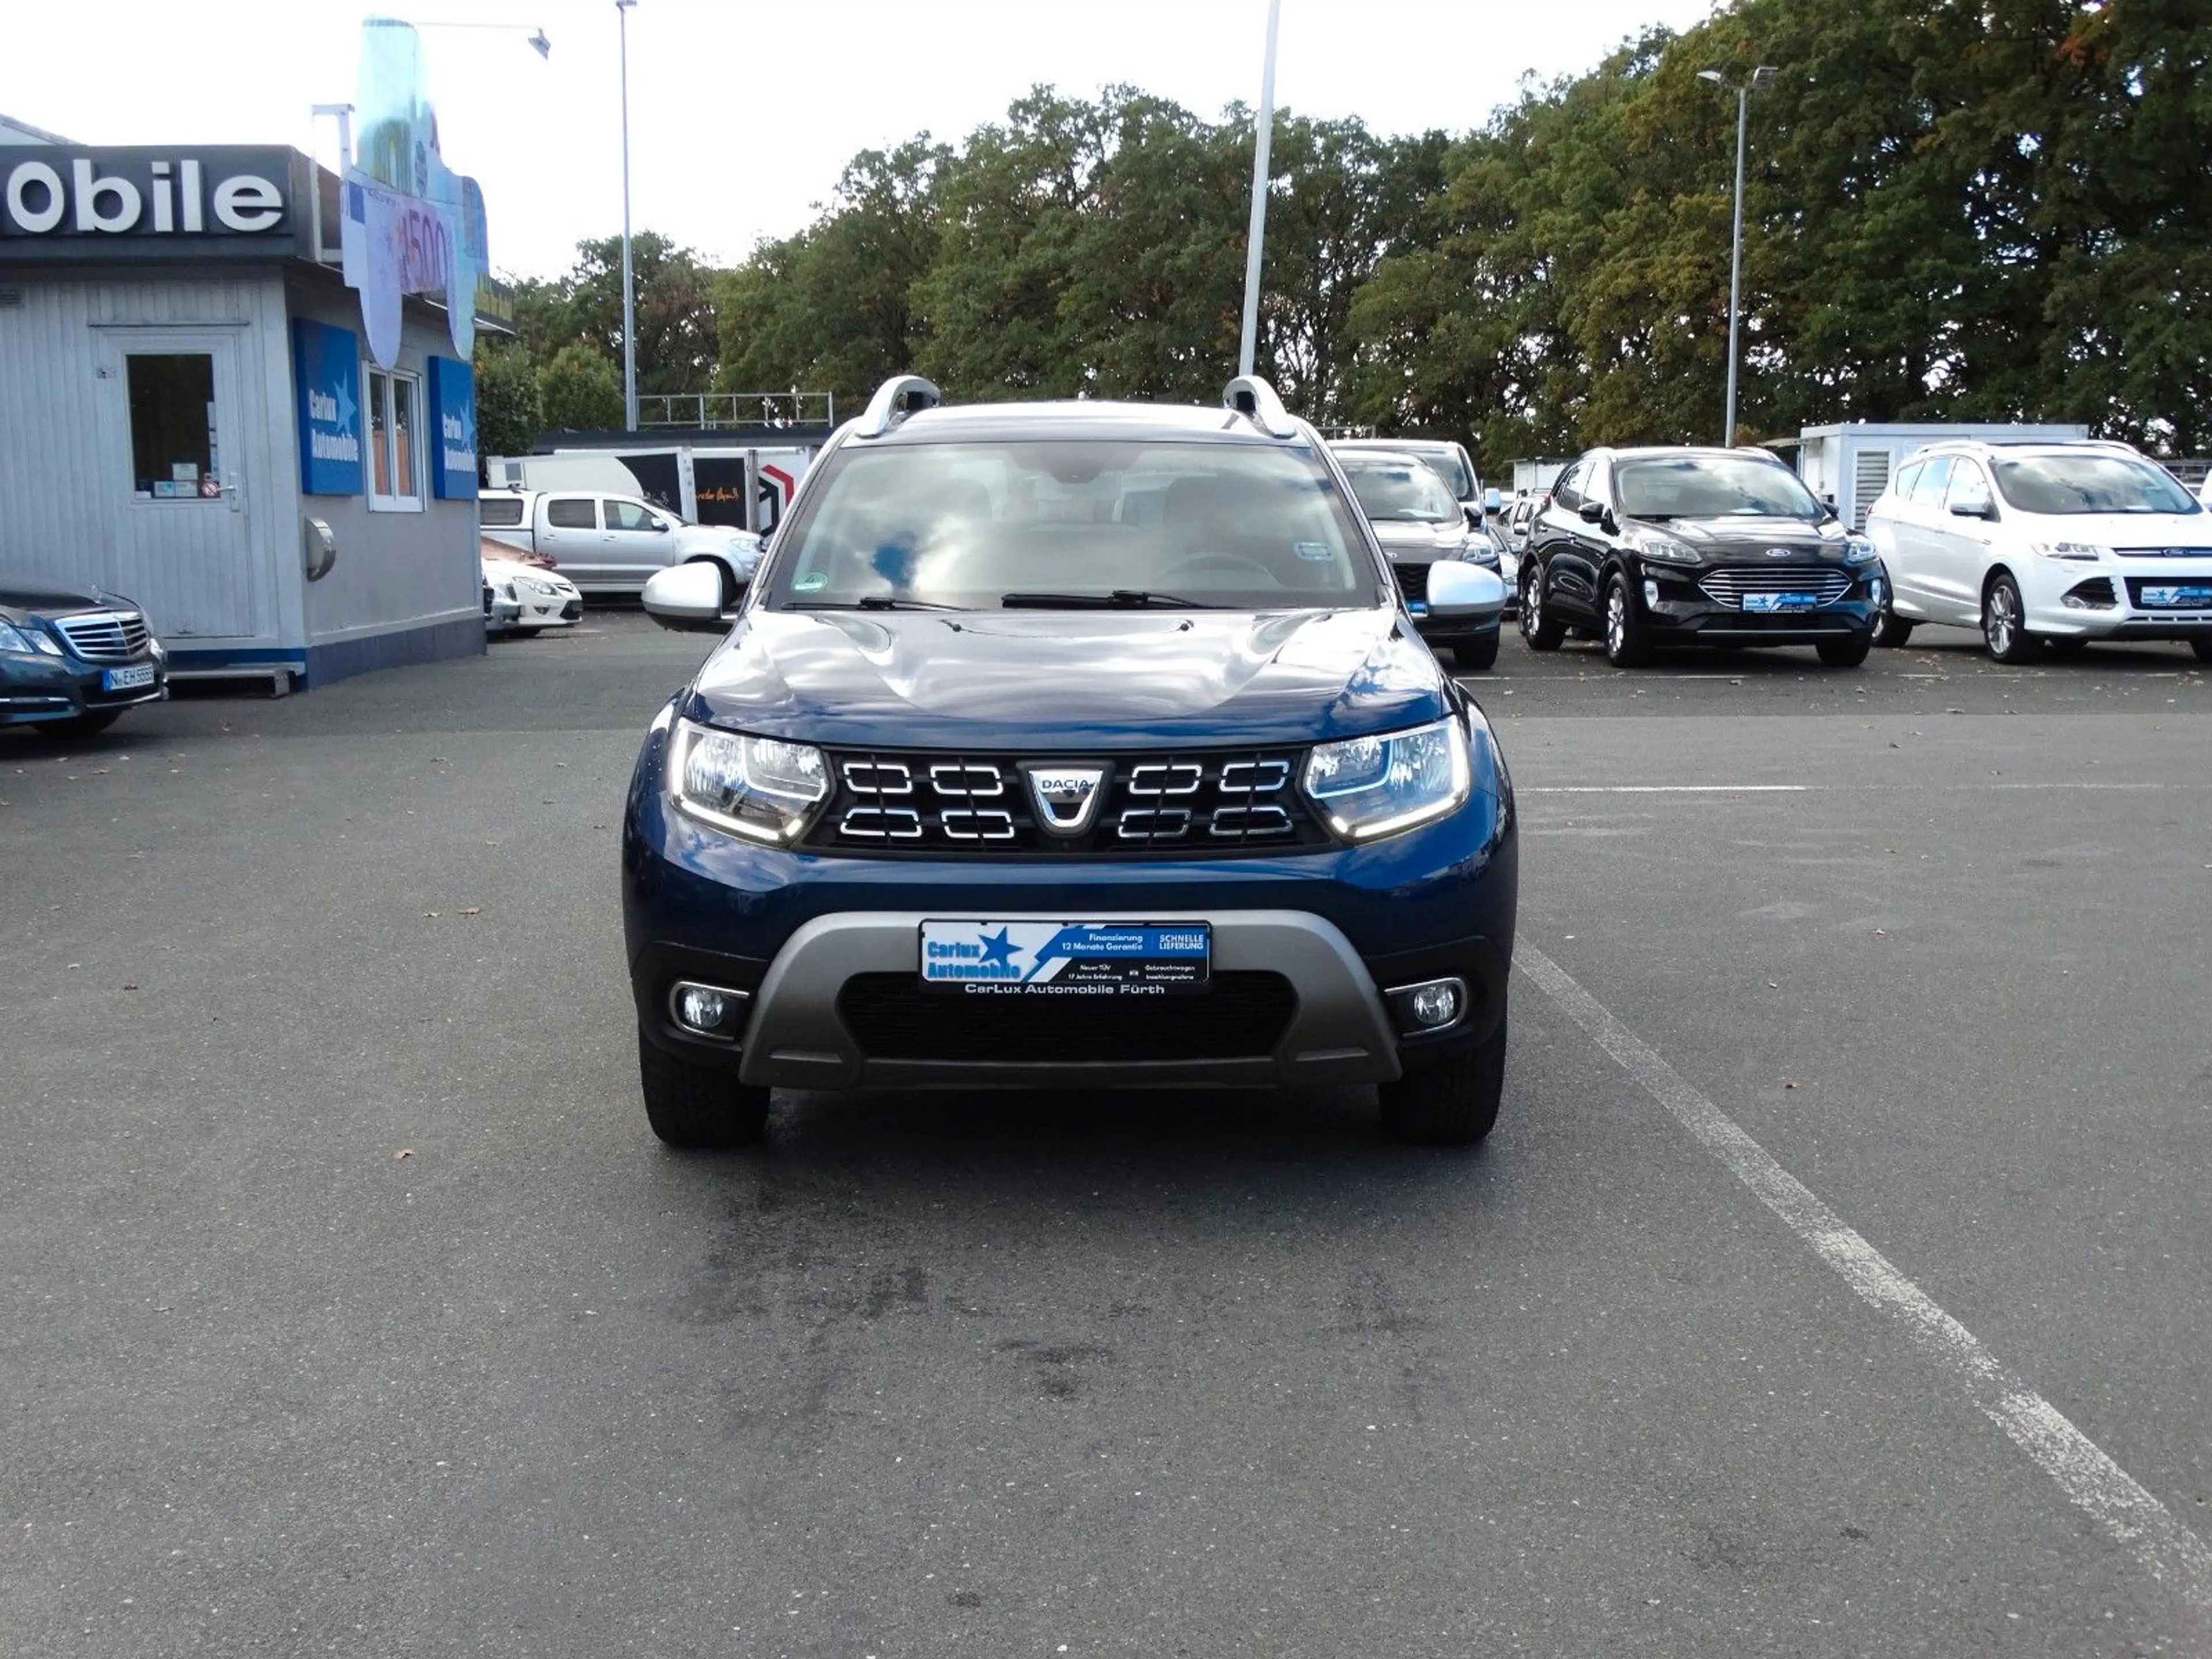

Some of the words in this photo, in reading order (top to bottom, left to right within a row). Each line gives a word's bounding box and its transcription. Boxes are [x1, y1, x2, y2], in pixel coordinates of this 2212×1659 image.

[1042, 779, 1089, 789] DACIA
[1089, 934, 1143, 942] Finanzierung
[1159, 934, 1204, 942] SCHNELLE
[927, 941, 980, 958] Carlux
[927, 962, 1021, 978] Automobile
[965, 984, 1021, 994] CarLux
[1025, 984, 1113, 994] Automobile
[1120, 984, 1165, 994] Fürth
